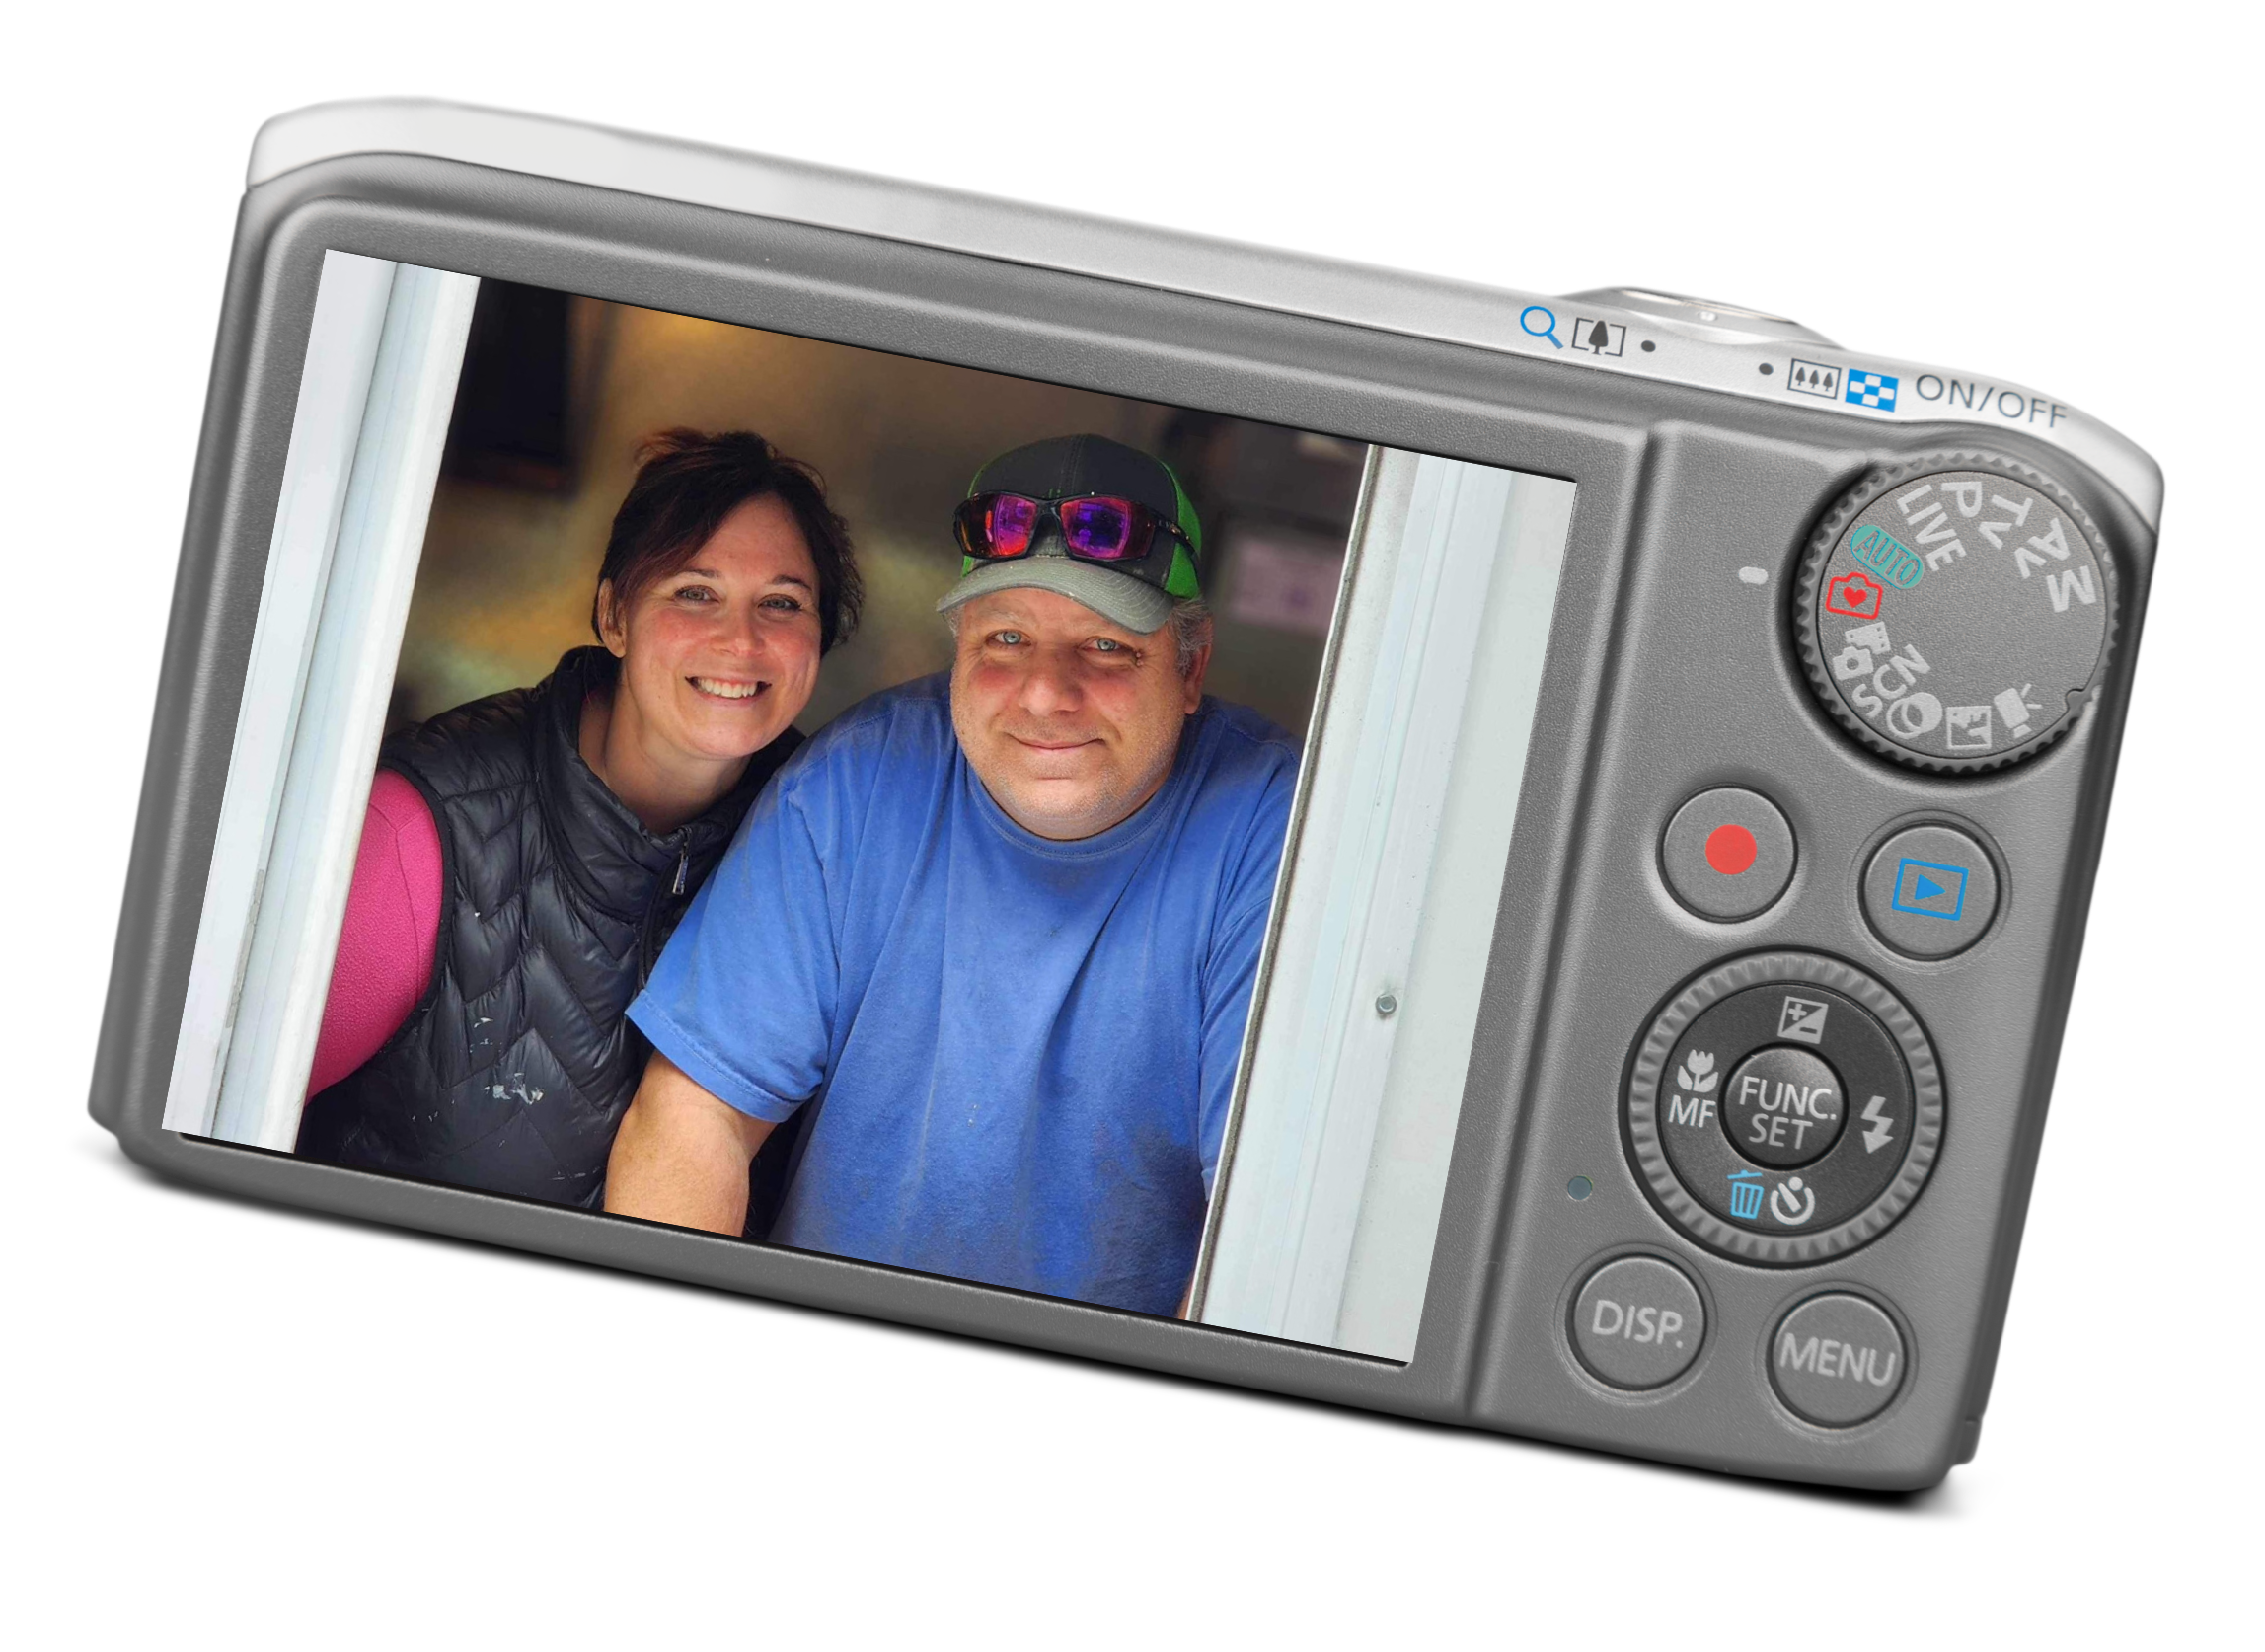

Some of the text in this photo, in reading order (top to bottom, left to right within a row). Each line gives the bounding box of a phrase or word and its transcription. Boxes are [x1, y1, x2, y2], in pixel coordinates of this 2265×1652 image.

[1915, 373, 2068, 429] ON/OFF
[1941, 481, 1982, 518] P
[1896, 484, 1968, 572] LIVE
[1852, 529, 1922, 588] AUTO
[2046, 565, 2097, 613] M
[1851, 643, 1931, 718] SCN
[1668, 1095, 1716, 1128] MF
[1738, 1076, 1837, 1121] FUNC.
[1749, 1113, 1813, 1150] SET
[1591, 1300, 1684, 1349] DISP.
[1779, 1333, 1896, 1386] MENU
